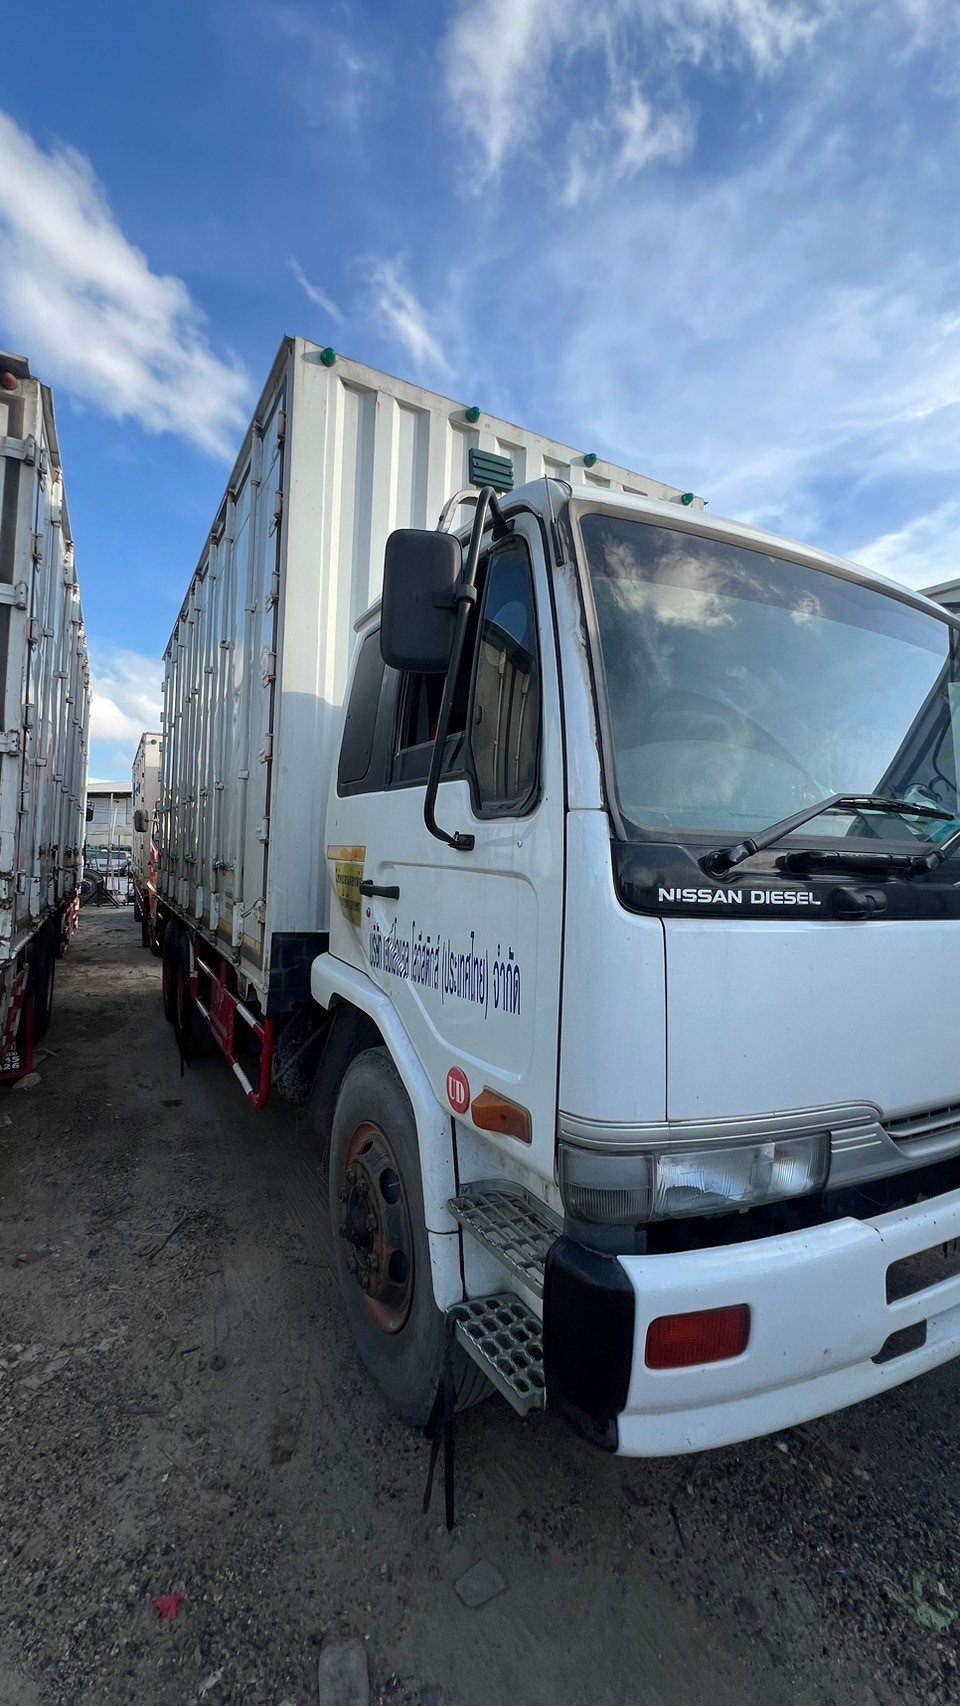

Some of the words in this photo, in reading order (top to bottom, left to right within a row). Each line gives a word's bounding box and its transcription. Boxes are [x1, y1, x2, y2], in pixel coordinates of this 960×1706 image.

[658, 888, 743, 904] NISSAN
[750, 890, 822, 905] DIESEL
[369, 922, 382, 969] บริษัท
[411, 920, 441, 990] โลจิสติกส์
[441, 930, 489, 1020] (ประเทศไทย)
[492, 943, 521, 1016] จำกัด
[448, 1075, 466, 1105] UD
